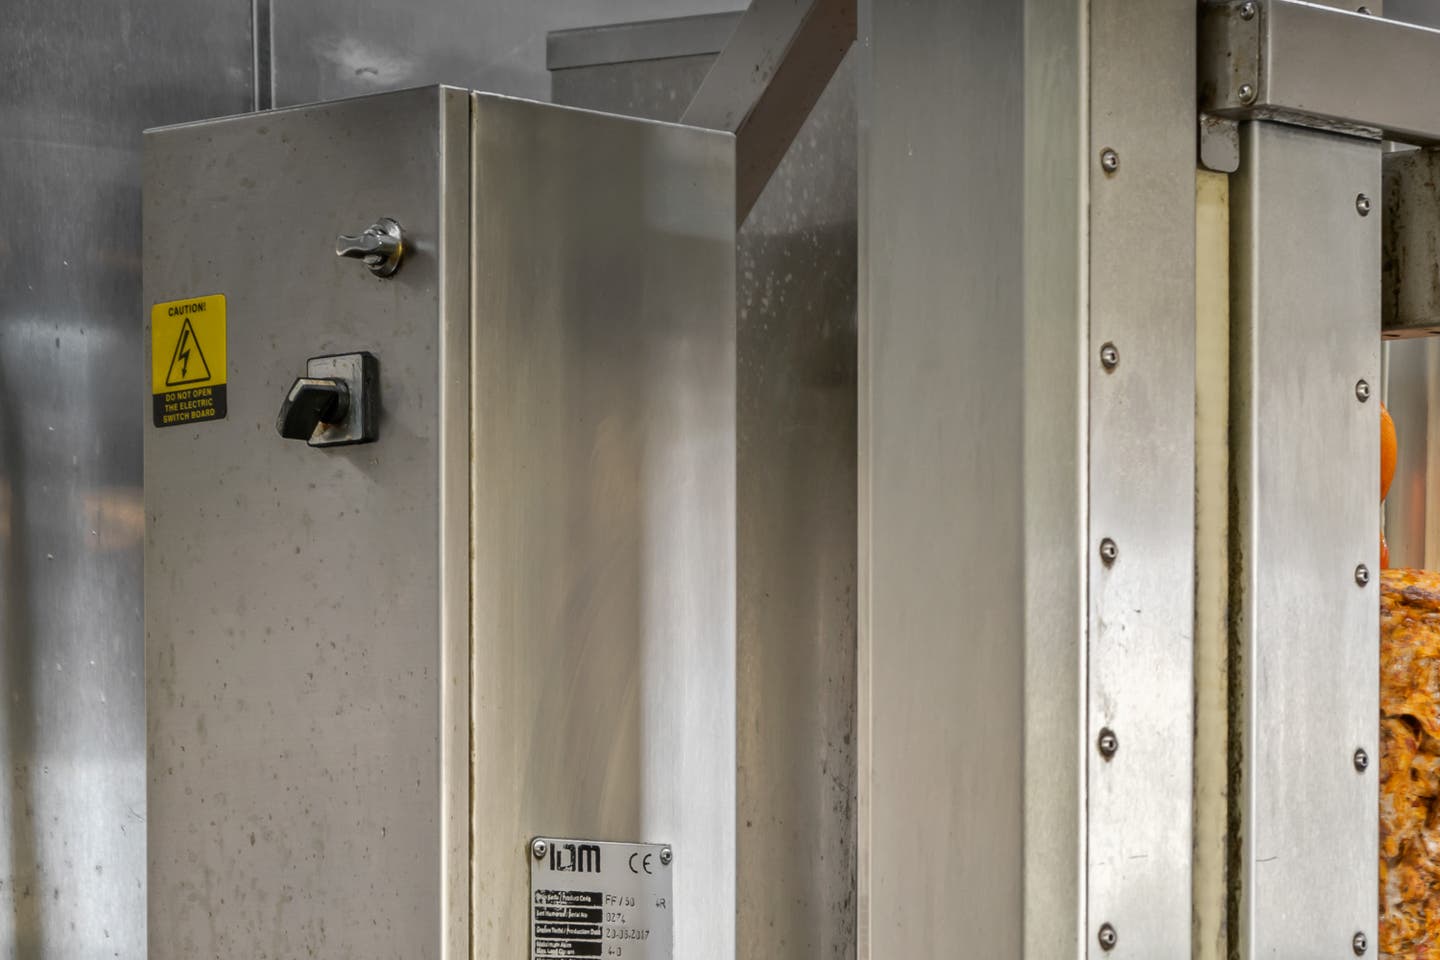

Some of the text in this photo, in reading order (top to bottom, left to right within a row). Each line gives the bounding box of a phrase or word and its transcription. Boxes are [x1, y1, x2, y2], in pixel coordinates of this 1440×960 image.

[168, 302, 206, 317] CAUTION!
[165, 388, 212, 402] DO NOT OPEN
[165, 398, 213, 413] THE ELECTRIC
[163, 408, 215, 423] SWITCH BOARD
